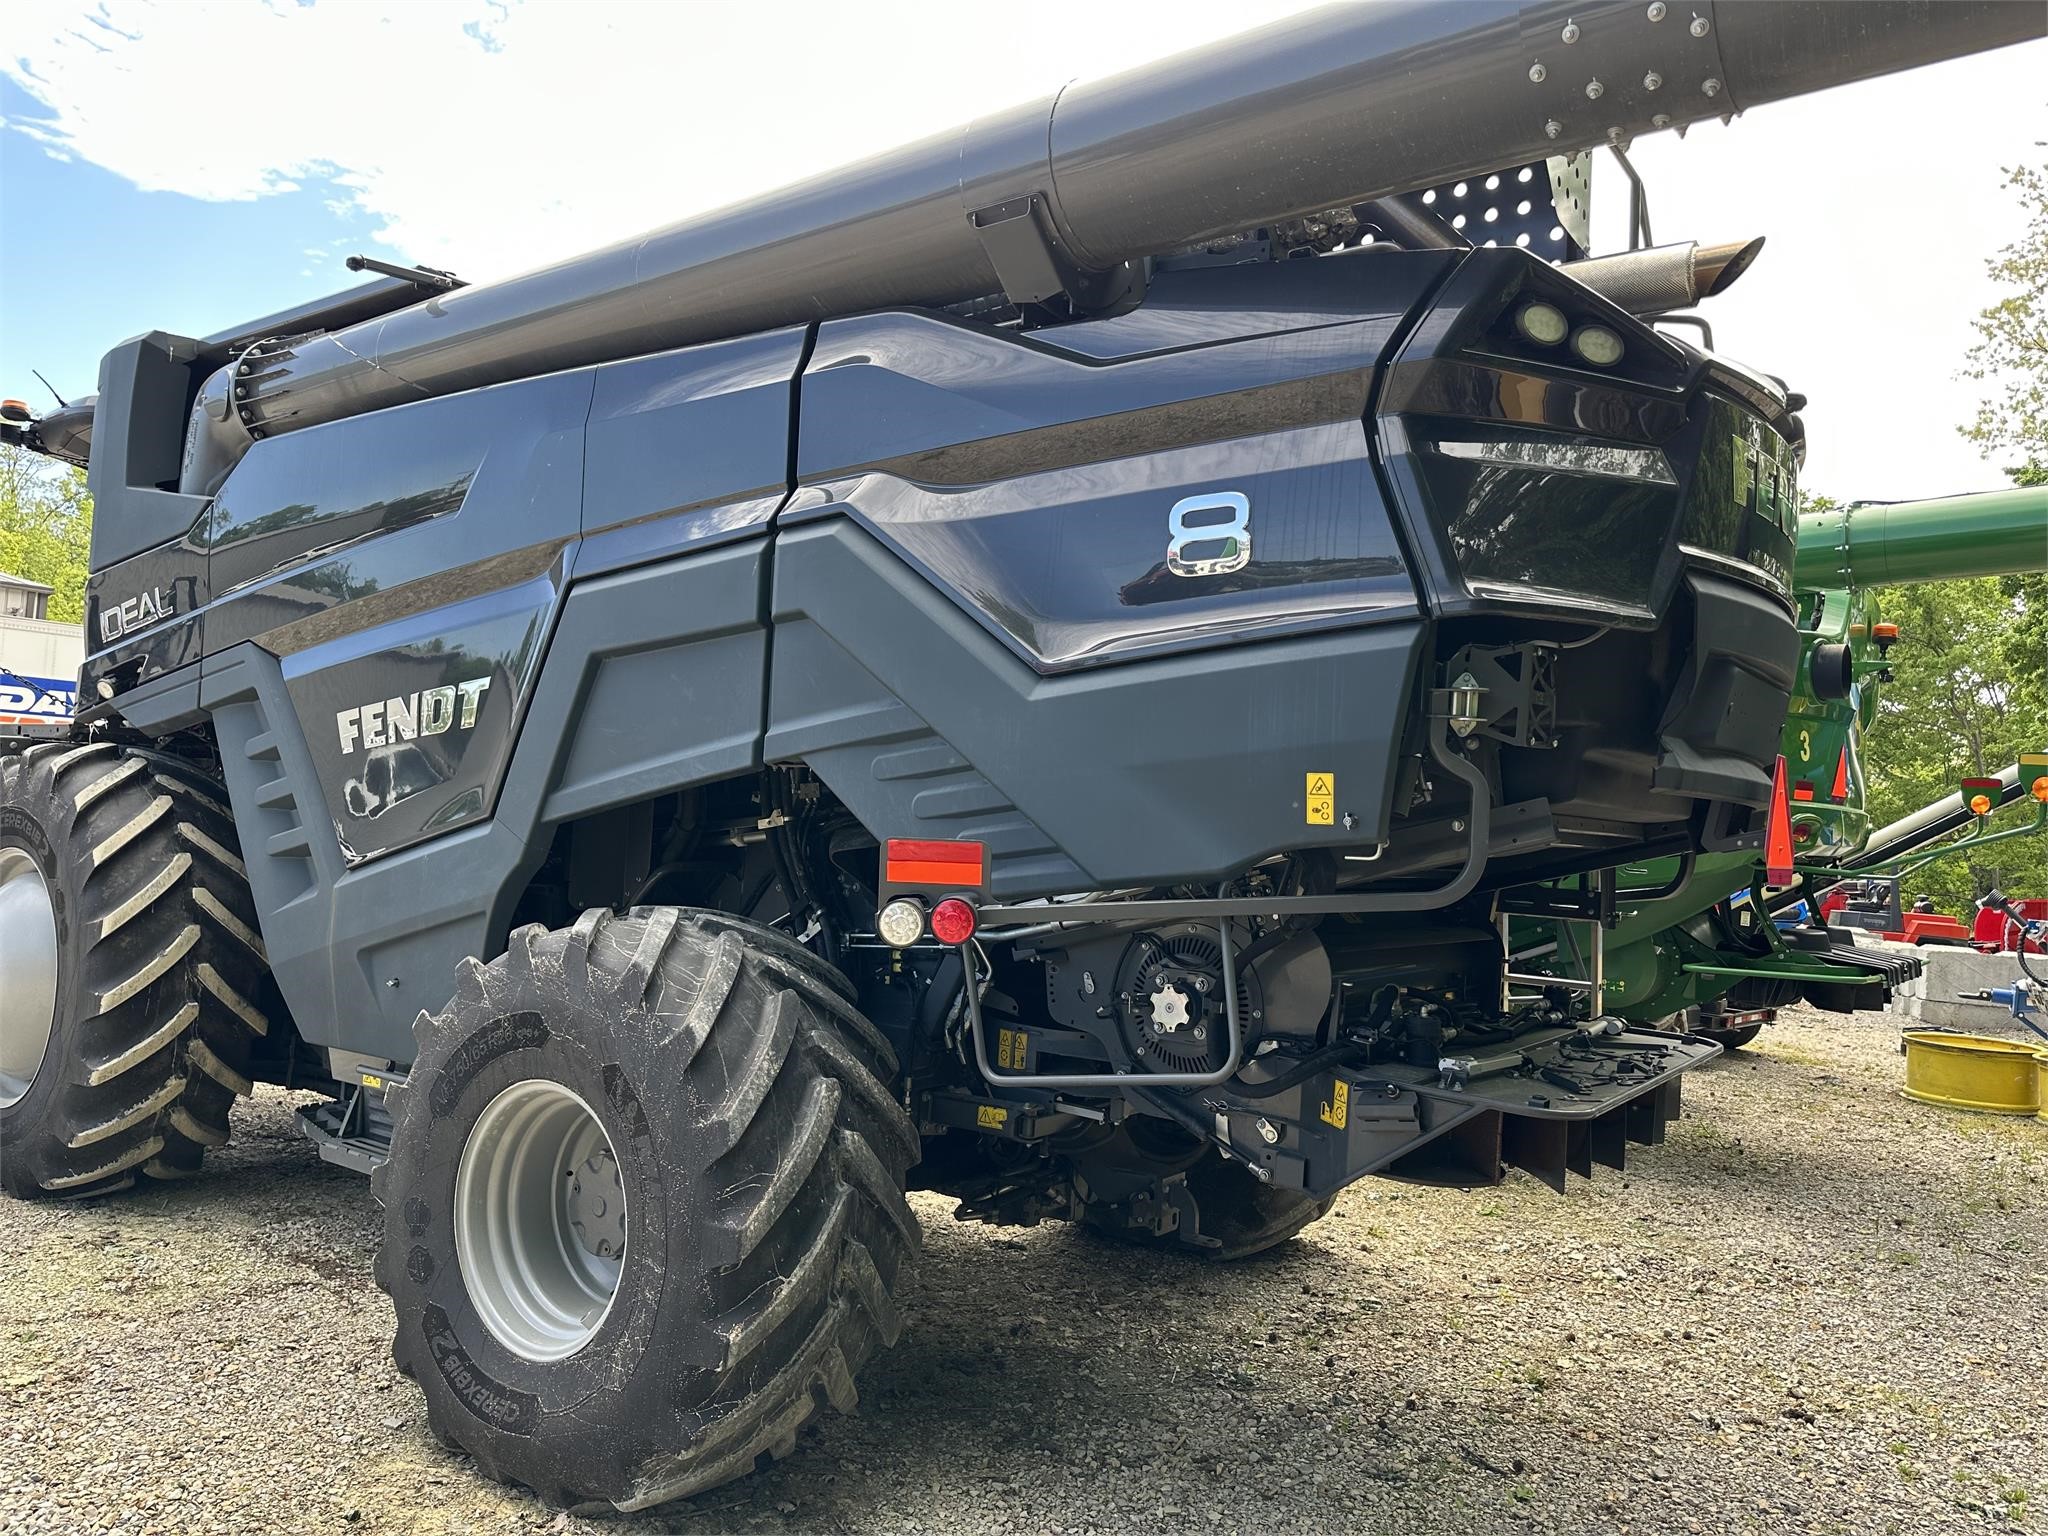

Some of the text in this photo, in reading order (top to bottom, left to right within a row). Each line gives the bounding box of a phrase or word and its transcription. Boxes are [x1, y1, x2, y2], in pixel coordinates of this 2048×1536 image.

[1167, 491, 1251, 578] 8
[100, 587, 173, 643] IDEAL
[337, 676, 491, 755] FENDT
[1800, 730, 1810, 762] 3
[431, 1326, 520, 1422] CEREXBIB 2
